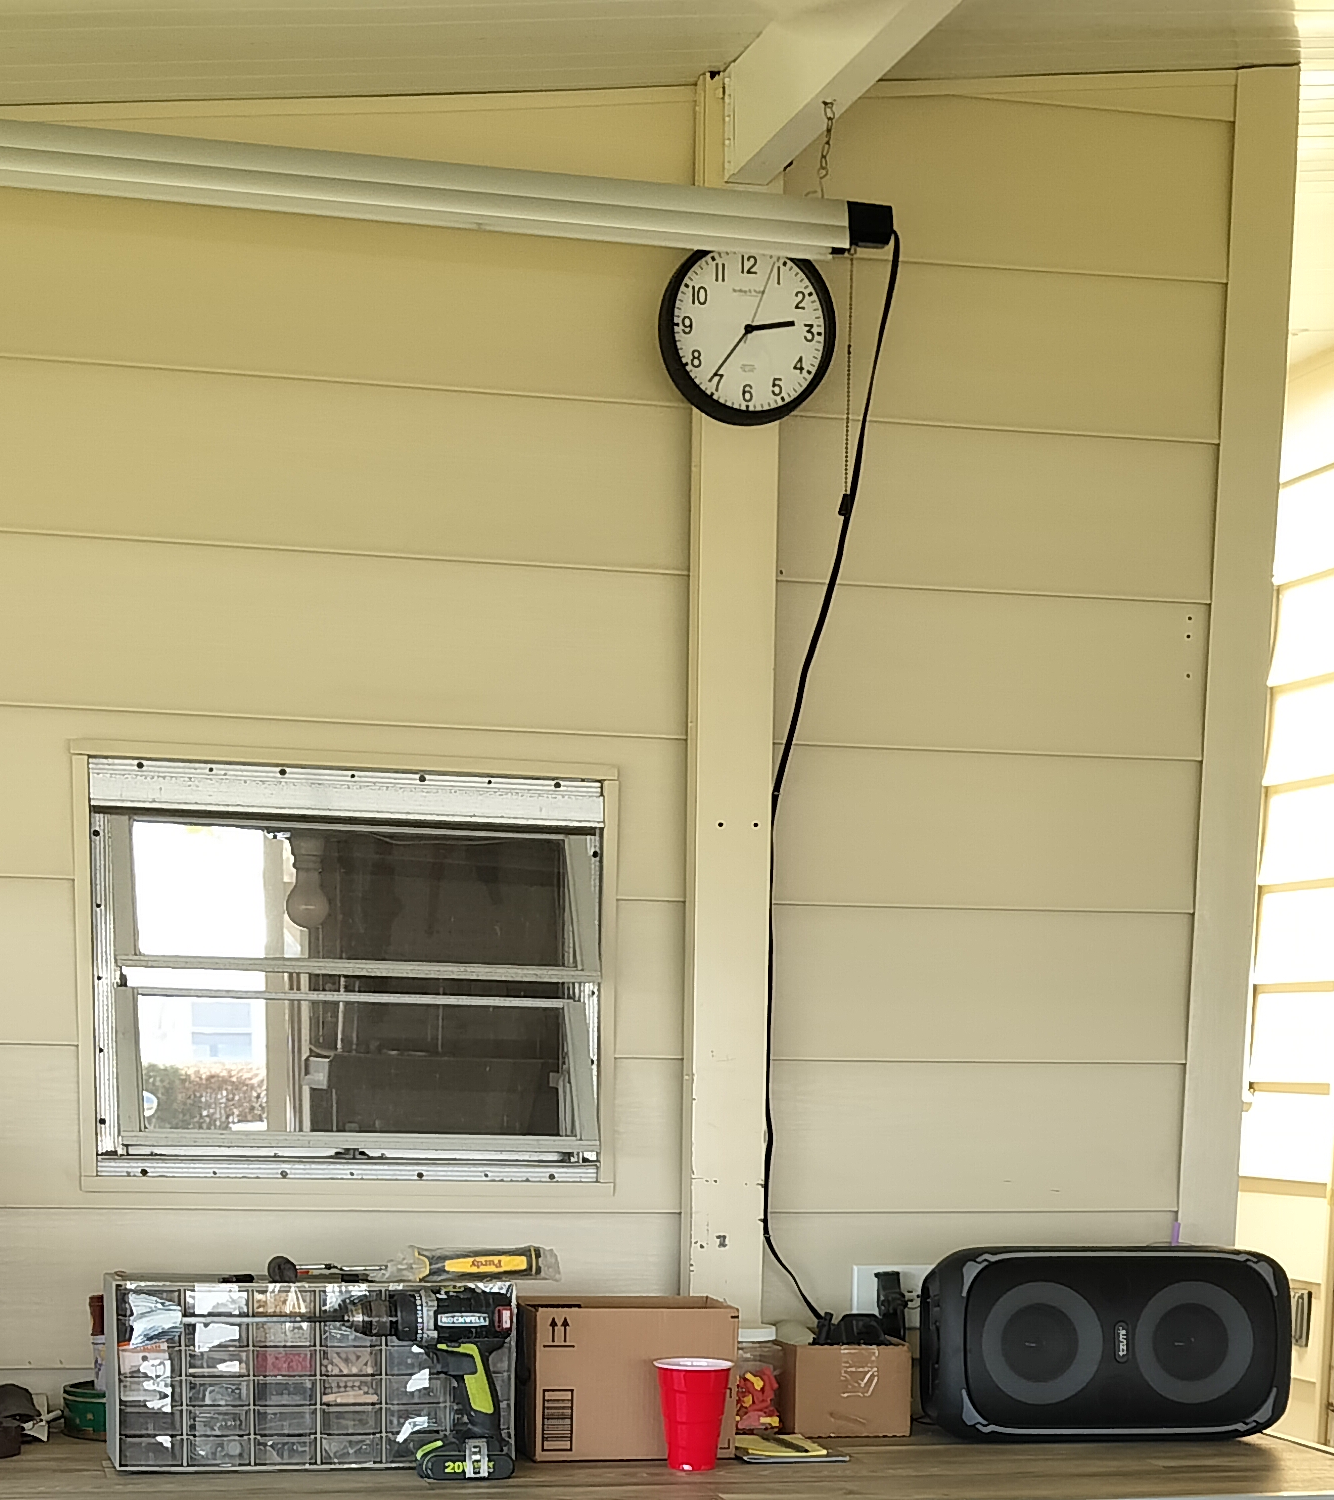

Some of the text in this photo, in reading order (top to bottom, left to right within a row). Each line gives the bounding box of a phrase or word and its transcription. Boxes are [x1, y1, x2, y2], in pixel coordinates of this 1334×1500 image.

[714, 262, 726, 283] 11
[740, 255, 758, 275] 12
[776, 265, 782, 285] 1
[691, 285, 708, 306] 10
[794, 290, 806, 310] 2
[681, 315, 693, 335] 9
[803, 323, 815, 343] 3
[690, 349, 702, 368] 8
[792, 356, 805, 374] 4
[712, 373, 724, 392] 7
[771, 377, 783, 396] 5
[741, 384, 753, 402] 6
[470, 1259, 503, 1269] Purdy
[441, 1316, 485, 1324] ROCKWELL
